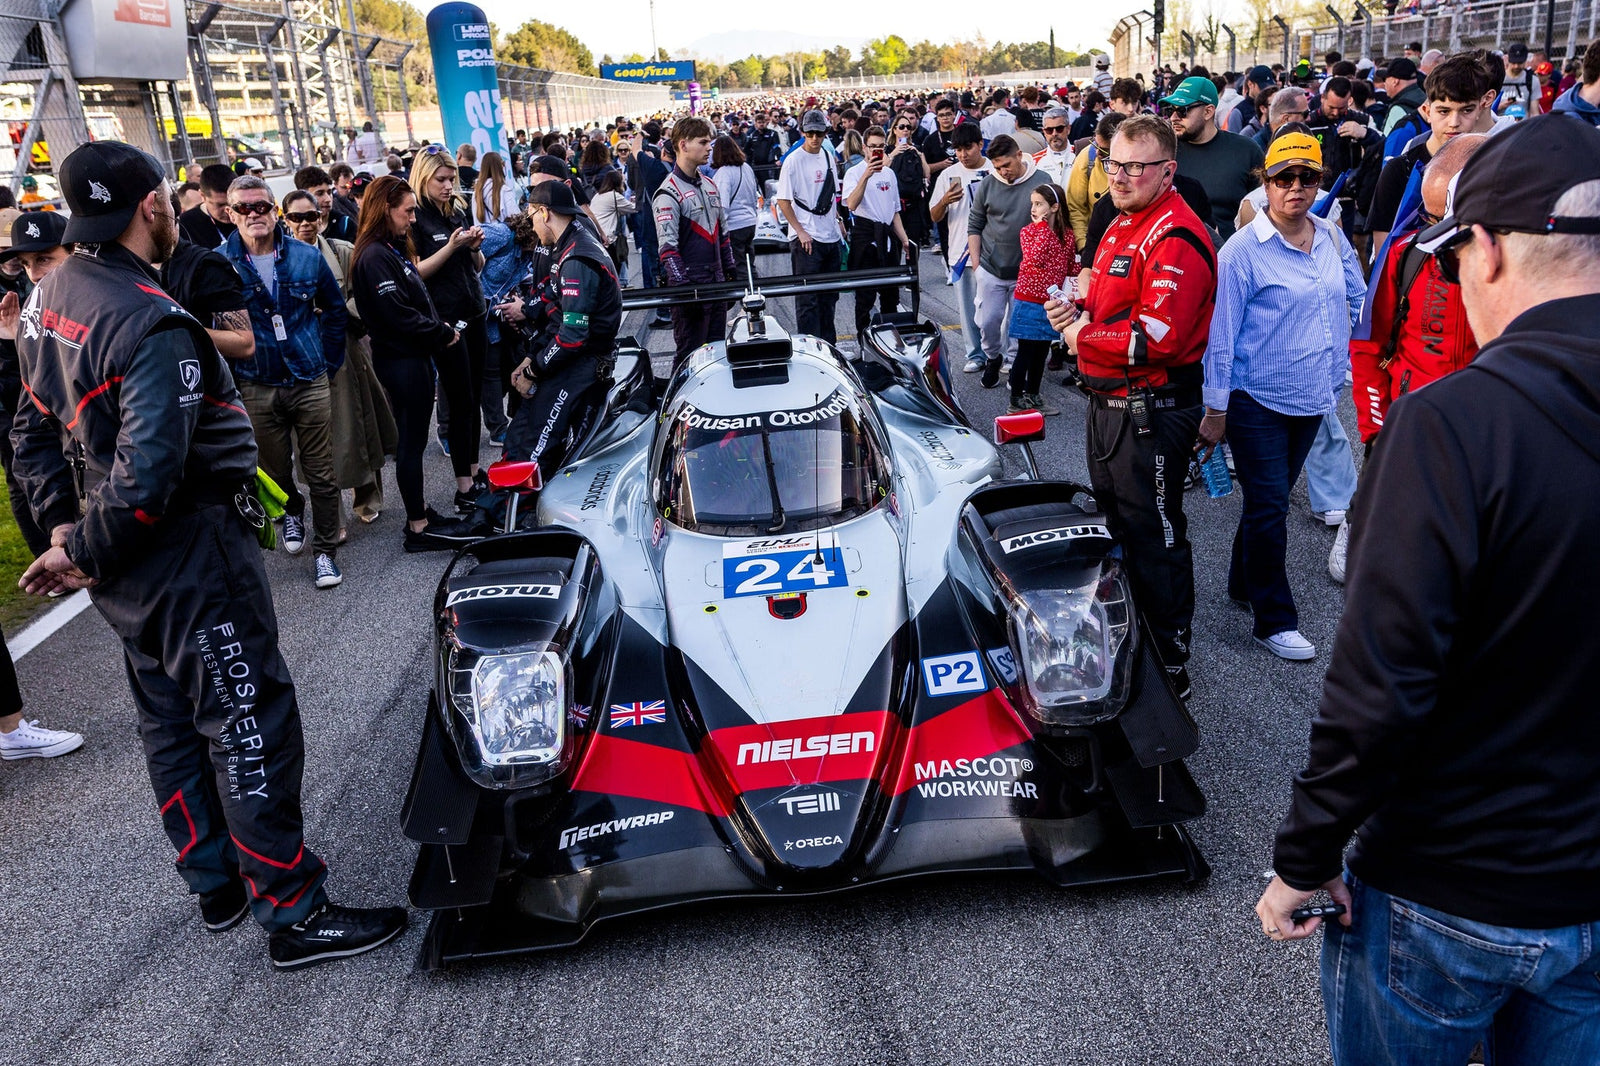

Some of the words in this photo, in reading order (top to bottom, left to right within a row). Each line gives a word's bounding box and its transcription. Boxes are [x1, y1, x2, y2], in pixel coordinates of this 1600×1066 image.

[614, 66, 676, 79] GOODYEAR
[1152, 280, 1178, 290] MOTUL
[678, 404, 762, 430] Borusan
[769, 390, 850, 426] Otomotiv
[747, 536, 814, 549] ELMS
[1009, 526, 1106, 550] MOTUL
[735, 552, 835, 594] 24
[451, 586, 554, 603] MOTUL
[195, 629, 235, 709] INVESTMENT
[930, 660, 978, 687] P2
[737, 731, 875, 766] NIELSEN
[917, 780, 1039, 799] WORKWEAR
[795, 835, 843, 847] ORECA
[317, 929, 345, 937] HRX
